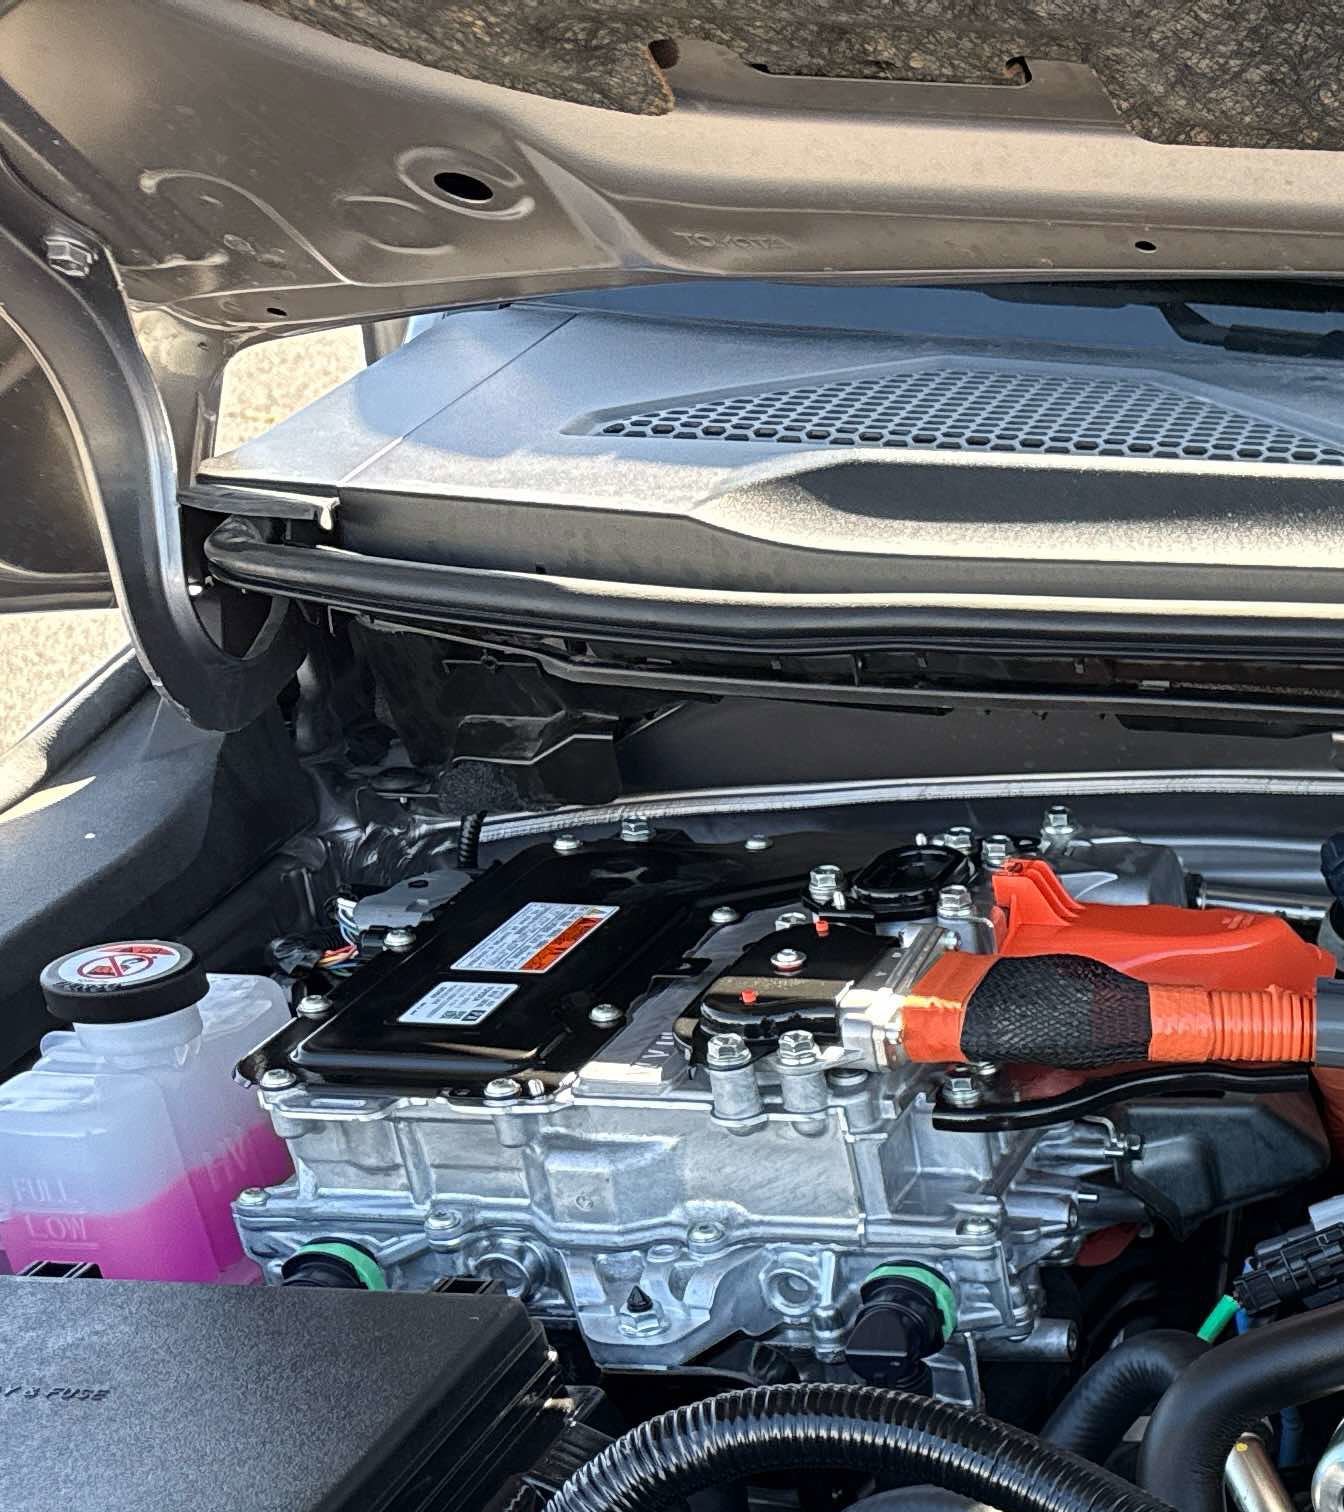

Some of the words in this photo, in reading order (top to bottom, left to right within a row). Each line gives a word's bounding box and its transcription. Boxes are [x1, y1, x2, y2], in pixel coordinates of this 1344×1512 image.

[671, 230, 798, 250] TOYOTA
[12, 1176, 78, 1202] FULL
[24, 1214, 88, 1241] LOW
[45, 1387, 111, 1401] FUSE
